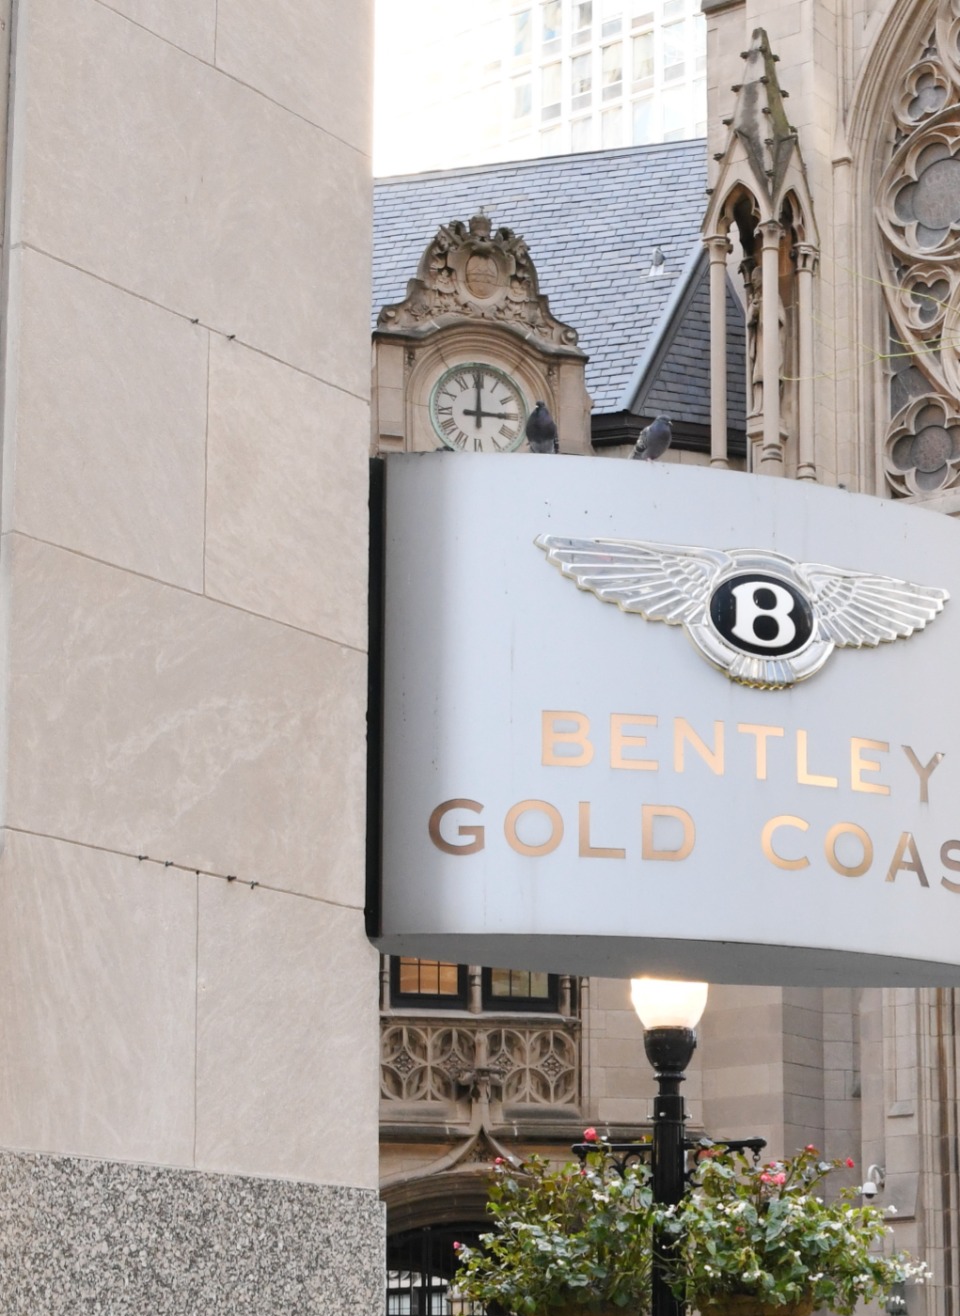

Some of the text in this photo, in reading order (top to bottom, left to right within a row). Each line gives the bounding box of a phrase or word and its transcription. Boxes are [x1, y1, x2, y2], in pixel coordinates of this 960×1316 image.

[732, 580, 797, 648] B
[541, 709, 946, 803] BENTLEY
[428, 798, 697, 862] GOLD
